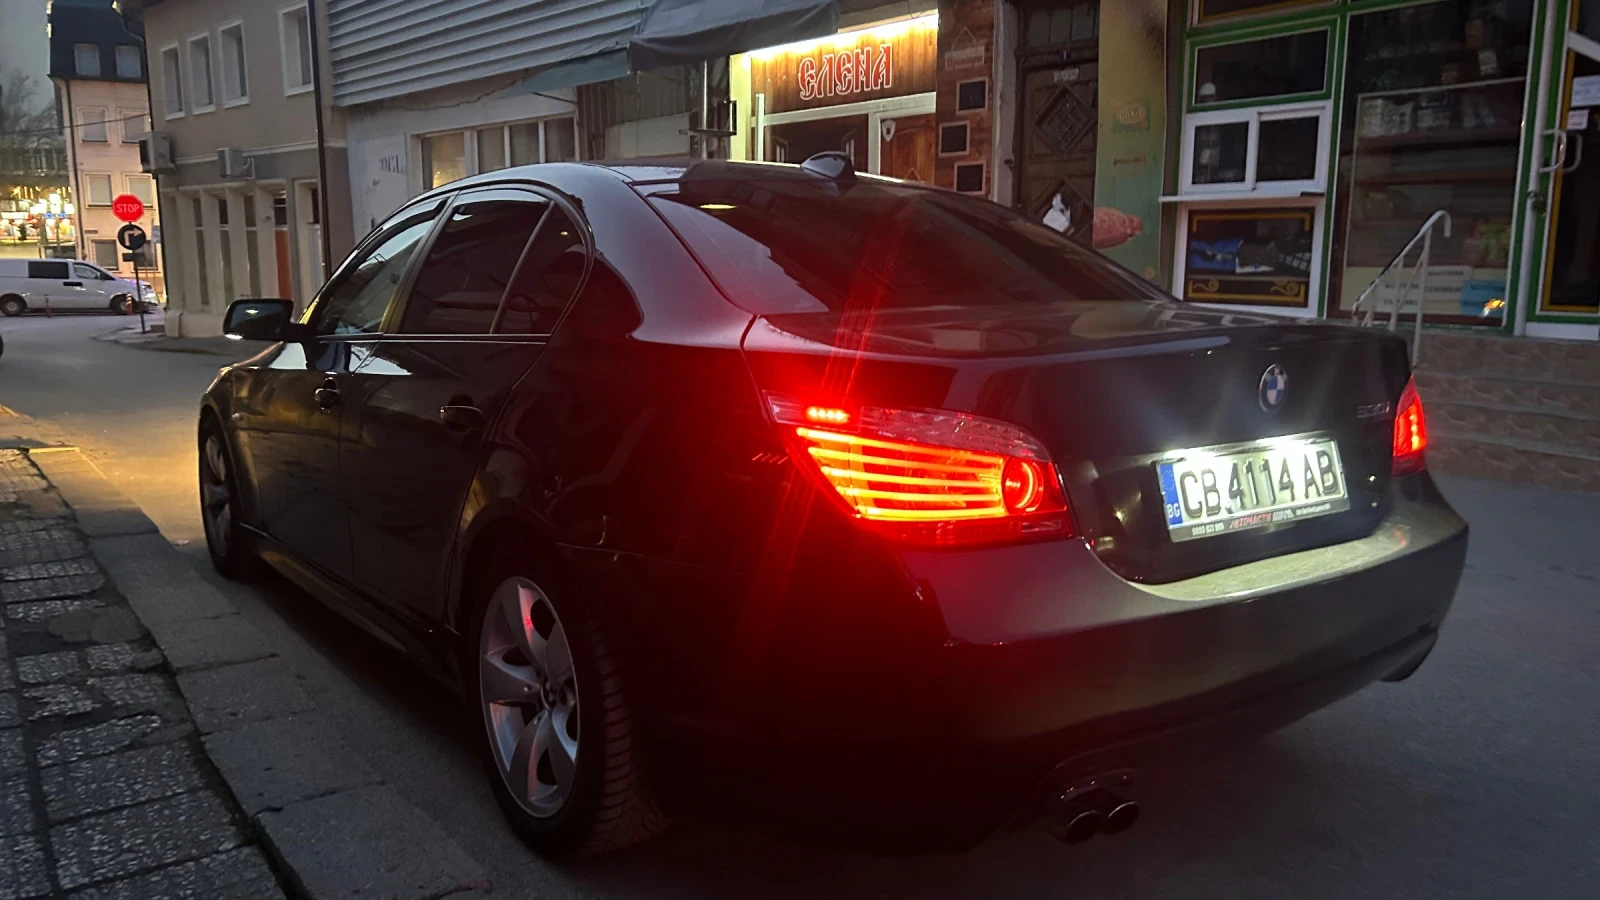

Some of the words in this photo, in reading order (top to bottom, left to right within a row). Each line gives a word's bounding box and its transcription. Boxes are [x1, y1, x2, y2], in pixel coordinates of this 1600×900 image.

[798, 43, 893, 101] ЕЛЕНА
[116, 203, 140, 214] STOP
[1179, 468, 1222, 519] CB
[1228, 457, 1296, 509] 4114
[1304, 449, 1338, 499] AB
[1167, 502, 1181, 520] BG
